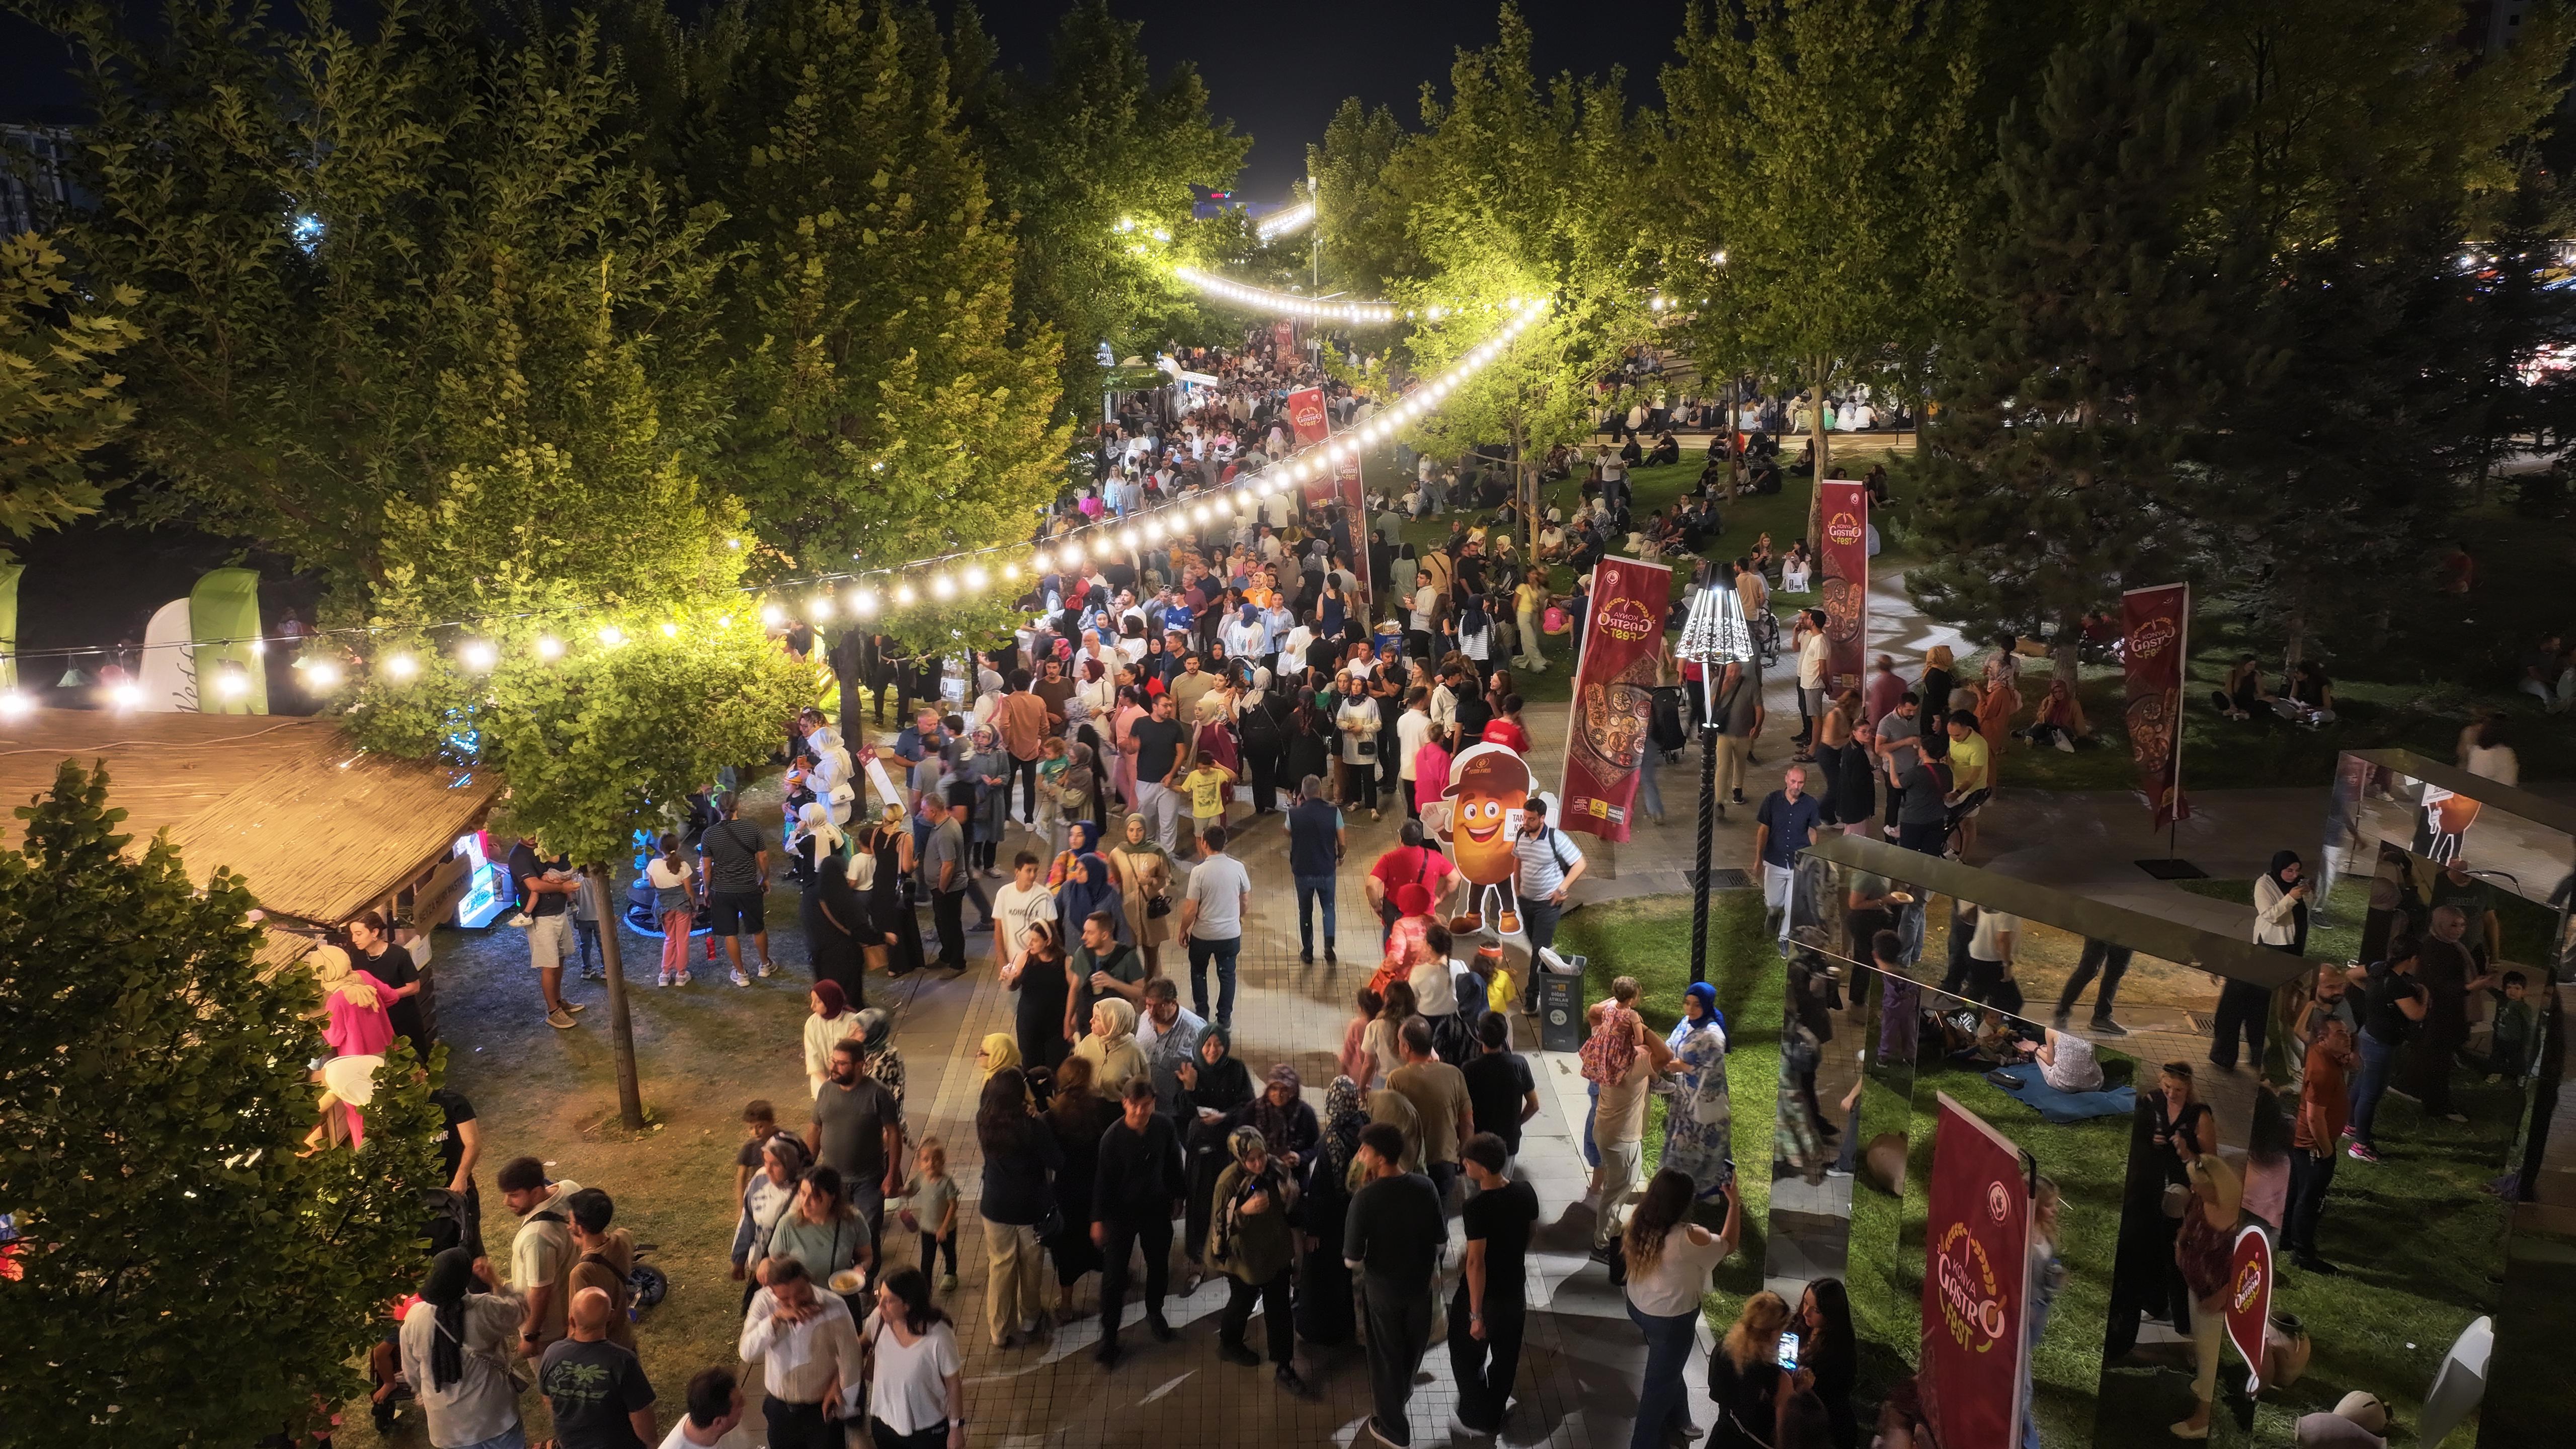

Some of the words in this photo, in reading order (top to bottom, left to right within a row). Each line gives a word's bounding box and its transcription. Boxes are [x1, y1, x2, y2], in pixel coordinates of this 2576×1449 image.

[1829, 525, 1862, 537] GASTRO
[2142, 629, 2166, 639] KONYA
[1952, 1258, 1977, 1298] KONYA
[1939, 1253, 2005, 1339] GASTRO
